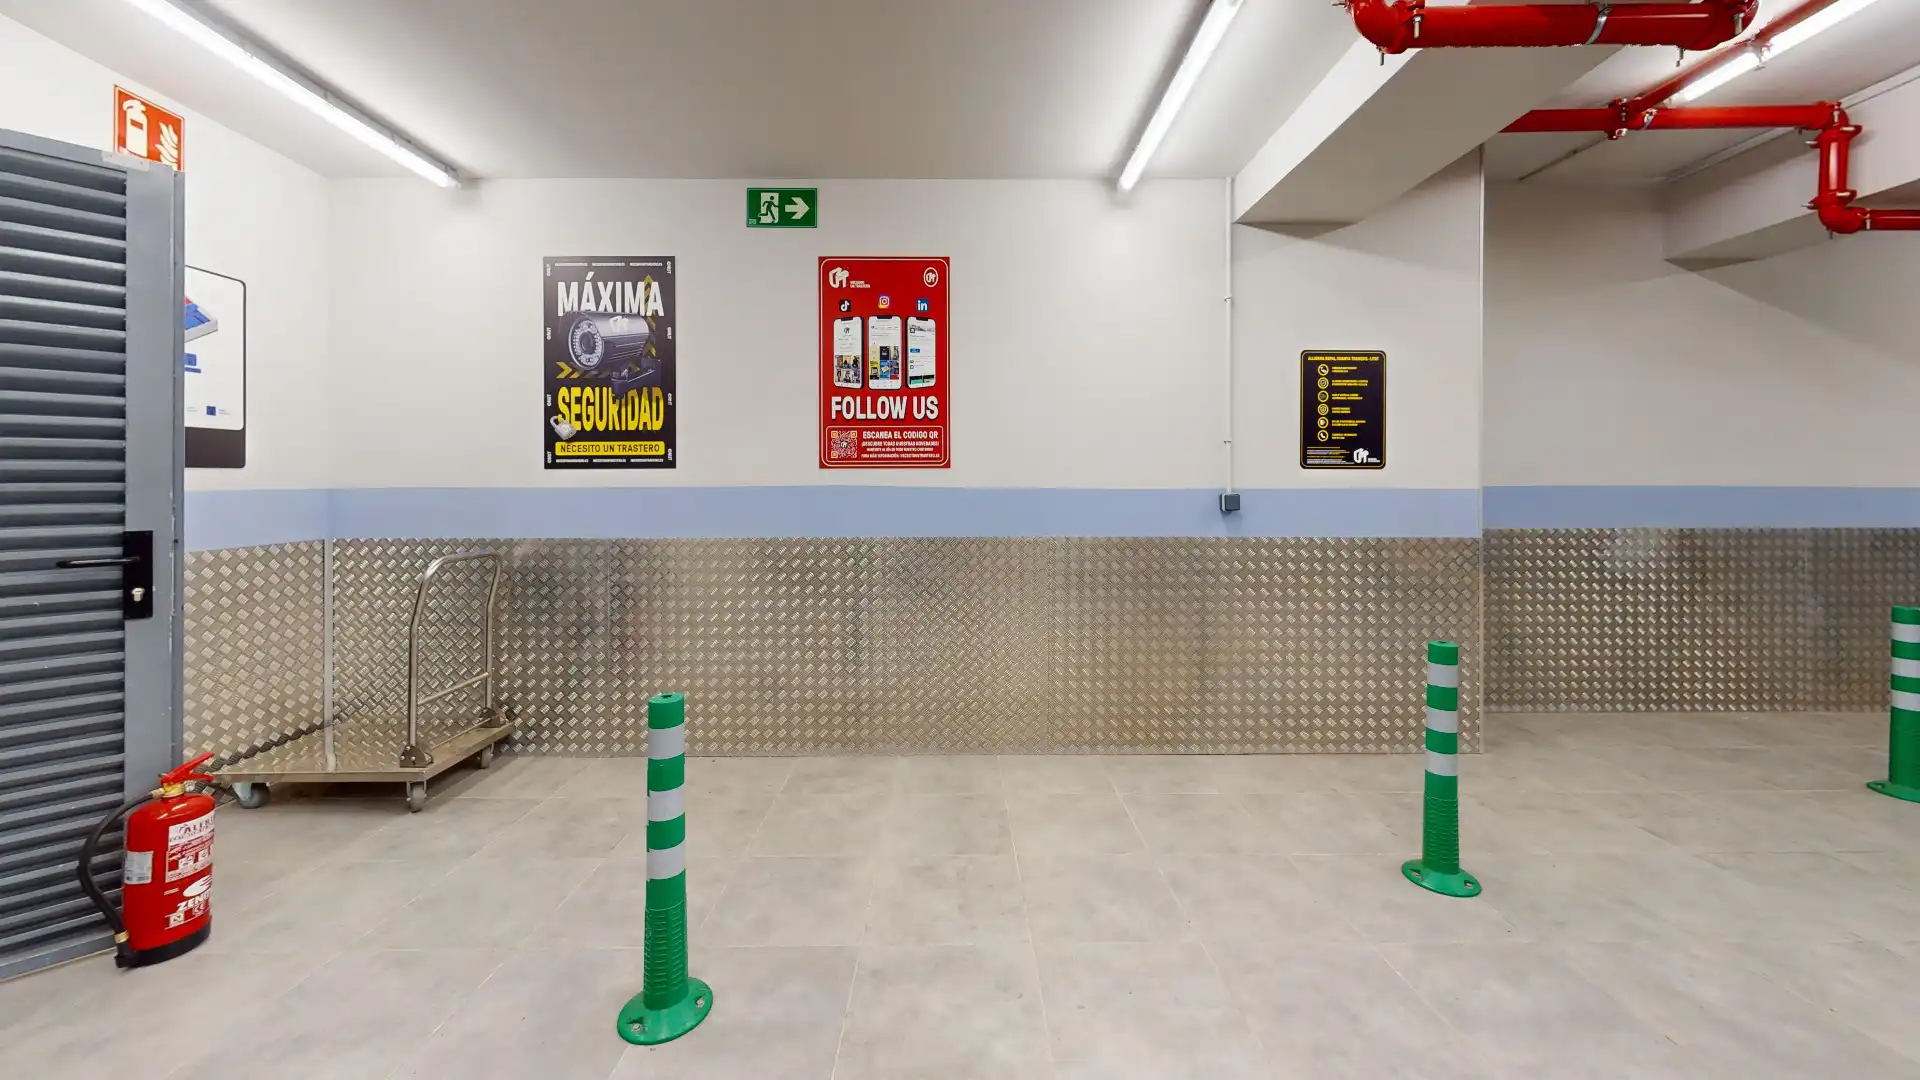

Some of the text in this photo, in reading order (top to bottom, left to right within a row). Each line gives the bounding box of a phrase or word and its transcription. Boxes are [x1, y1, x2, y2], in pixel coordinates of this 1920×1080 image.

[557, 271, 665, 317] MÁXIMA
[557, 386, 665, 431] SEGURIDAD
[831, 396, 939, 420] FOLLOW US
[862, 431, 938, 439] ESCANEA EL CODIGO QR
[560, 444, 660, 453] NECESITO UN TRASTERO
